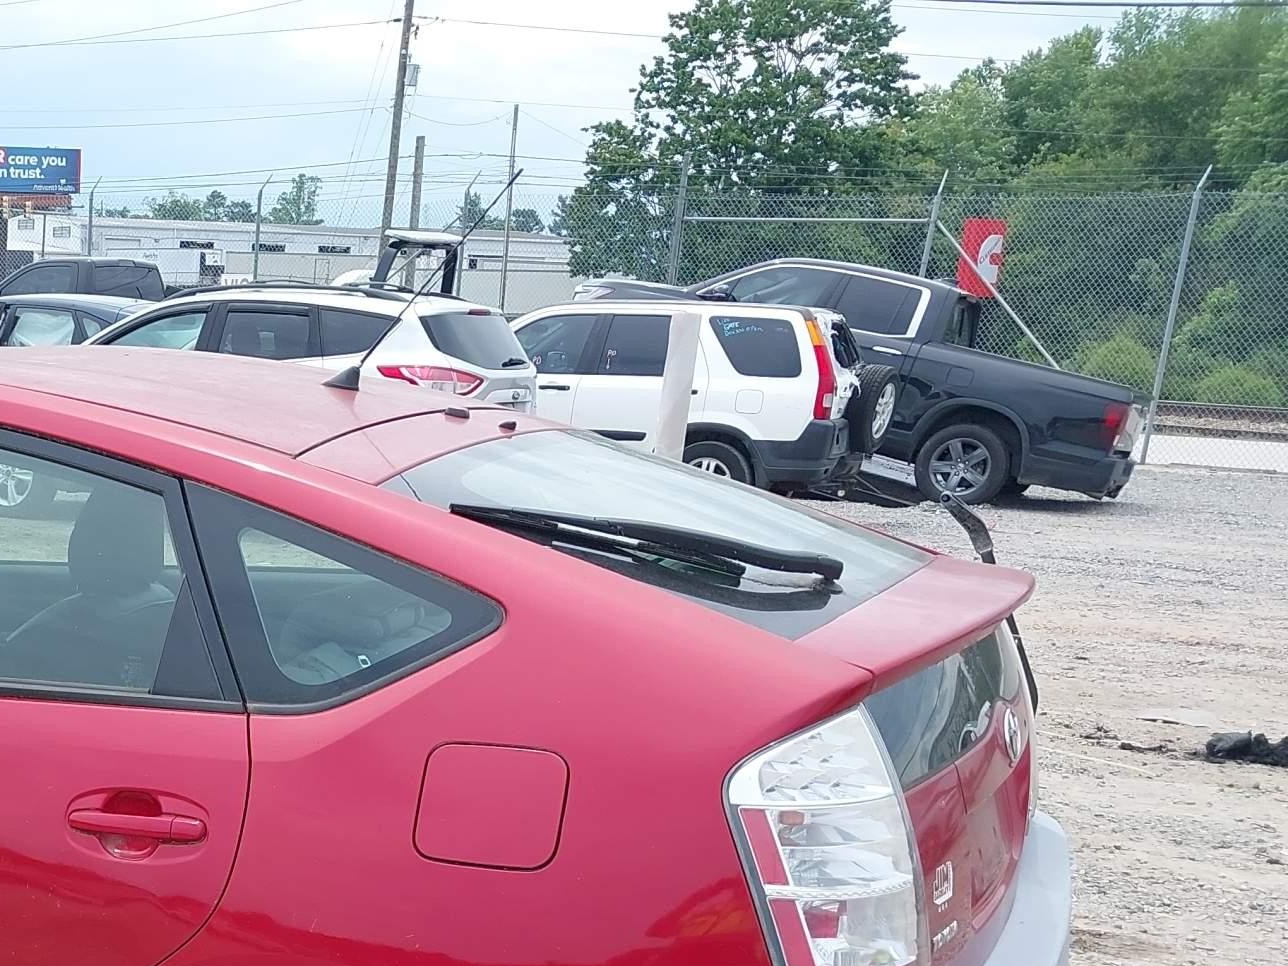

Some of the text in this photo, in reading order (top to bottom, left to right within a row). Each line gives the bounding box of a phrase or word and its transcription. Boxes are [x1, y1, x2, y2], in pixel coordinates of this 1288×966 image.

[8, 155, 38, 166] care
[41, 156, 66, 168] you
[9, 167, 45, 179] trust.
